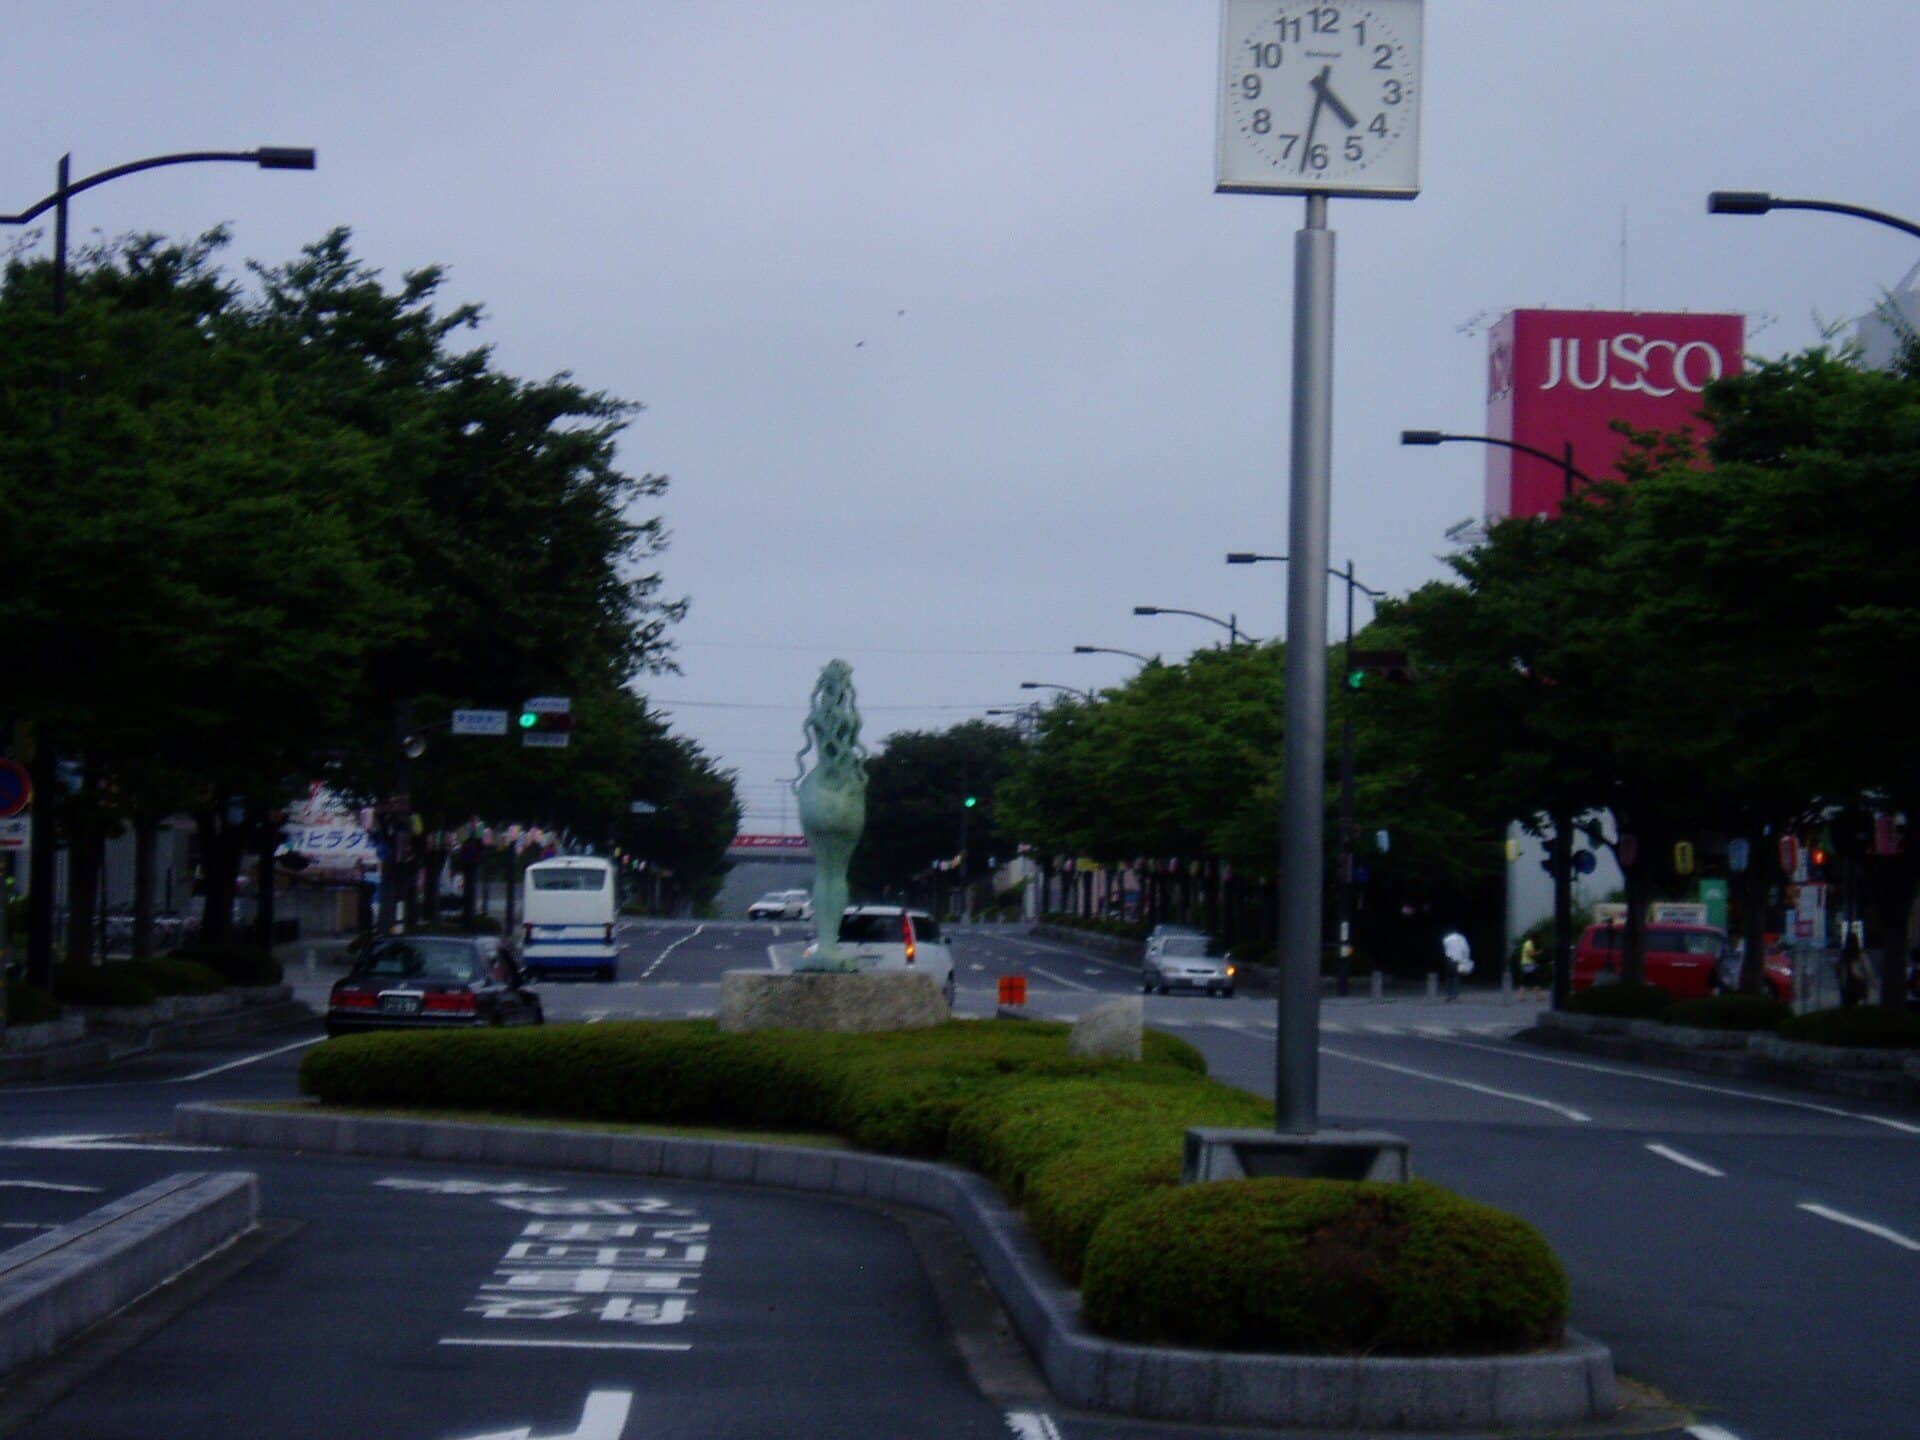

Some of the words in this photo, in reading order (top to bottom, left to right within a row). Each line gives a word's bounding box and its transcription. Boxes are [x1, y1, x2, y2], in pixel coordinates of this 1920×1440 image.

[1274, 17, 1300, 43] 11
[1307, 8, 1340, 33] 12
[1353, 20, 1365, 46] 1
[1250, 42, 1282, 69] 10
[1373, 44, 1394, 70] 2
[1242, 73, 1261, 100] 9
[1382, 79, 1403, 105] 3
[1252, 108, 1272, 134] 8
[1368, 112, 1388, 139] 4
[1278, 134, 1299, 159] 7
[1310, 144, 1328, 170] 6
[1344, 136, 1363, 161] 5
[1539, 332, 1723, 397] JUSCO
